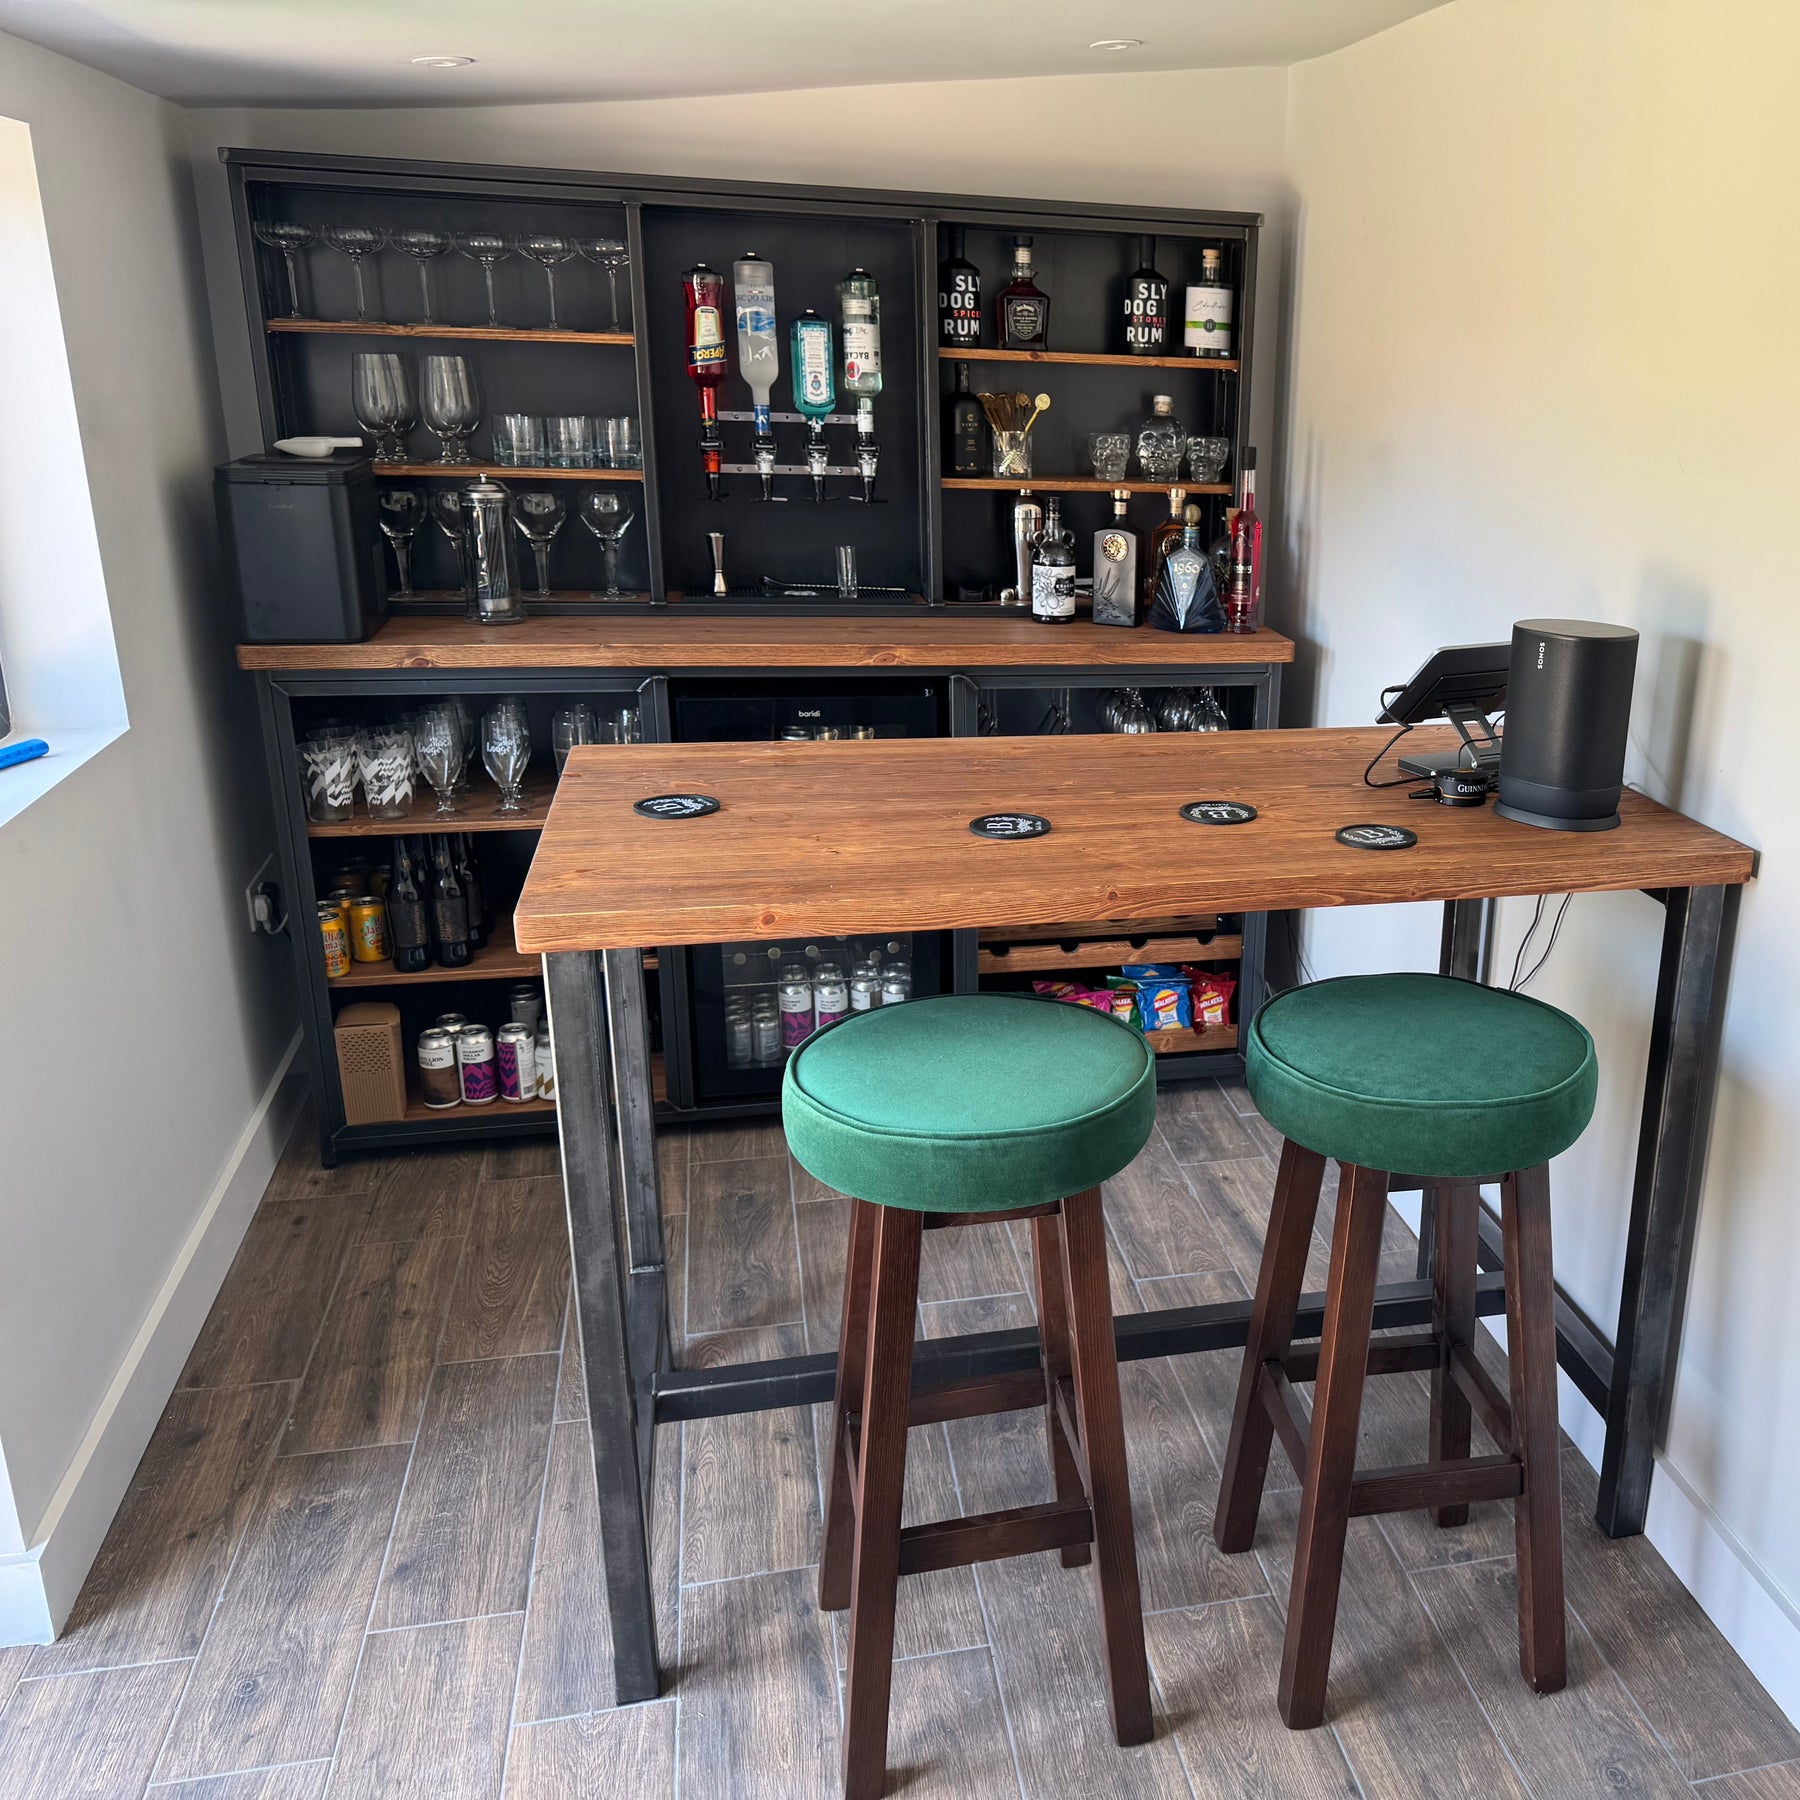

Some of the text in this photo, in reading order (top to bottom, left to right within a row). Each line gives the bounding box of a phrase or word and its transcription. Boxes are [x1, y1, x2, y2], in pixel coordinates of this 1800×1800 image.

[955, 274, 980, 292] SLY
[1138, 282, 1167, 300] SLY
[939, 292, 974, 309] DOG
[1124, 299, 1157, 316] DOG
[953, 310, 981, 318] SPICE
[944, 319, 980, 336] RUM
[1127, 326, 1162, 343] RUM
[693, 344, 725, 361] APEROL
[844, 351, 869, 360] BACAR
[1173, 562, 1199, 575] 1960
[1537, 642, 1545, 669] SONOS
[798, 710, 821, 718] baridi
[653, 803, 683, 812] B
[1208, 811, 1232, 819] B
[1355, 829, 1384, 838] B
[1154, 994, 1178, 1008] WALKERS
[1200, 995, 1223, 1008] WALKERS
